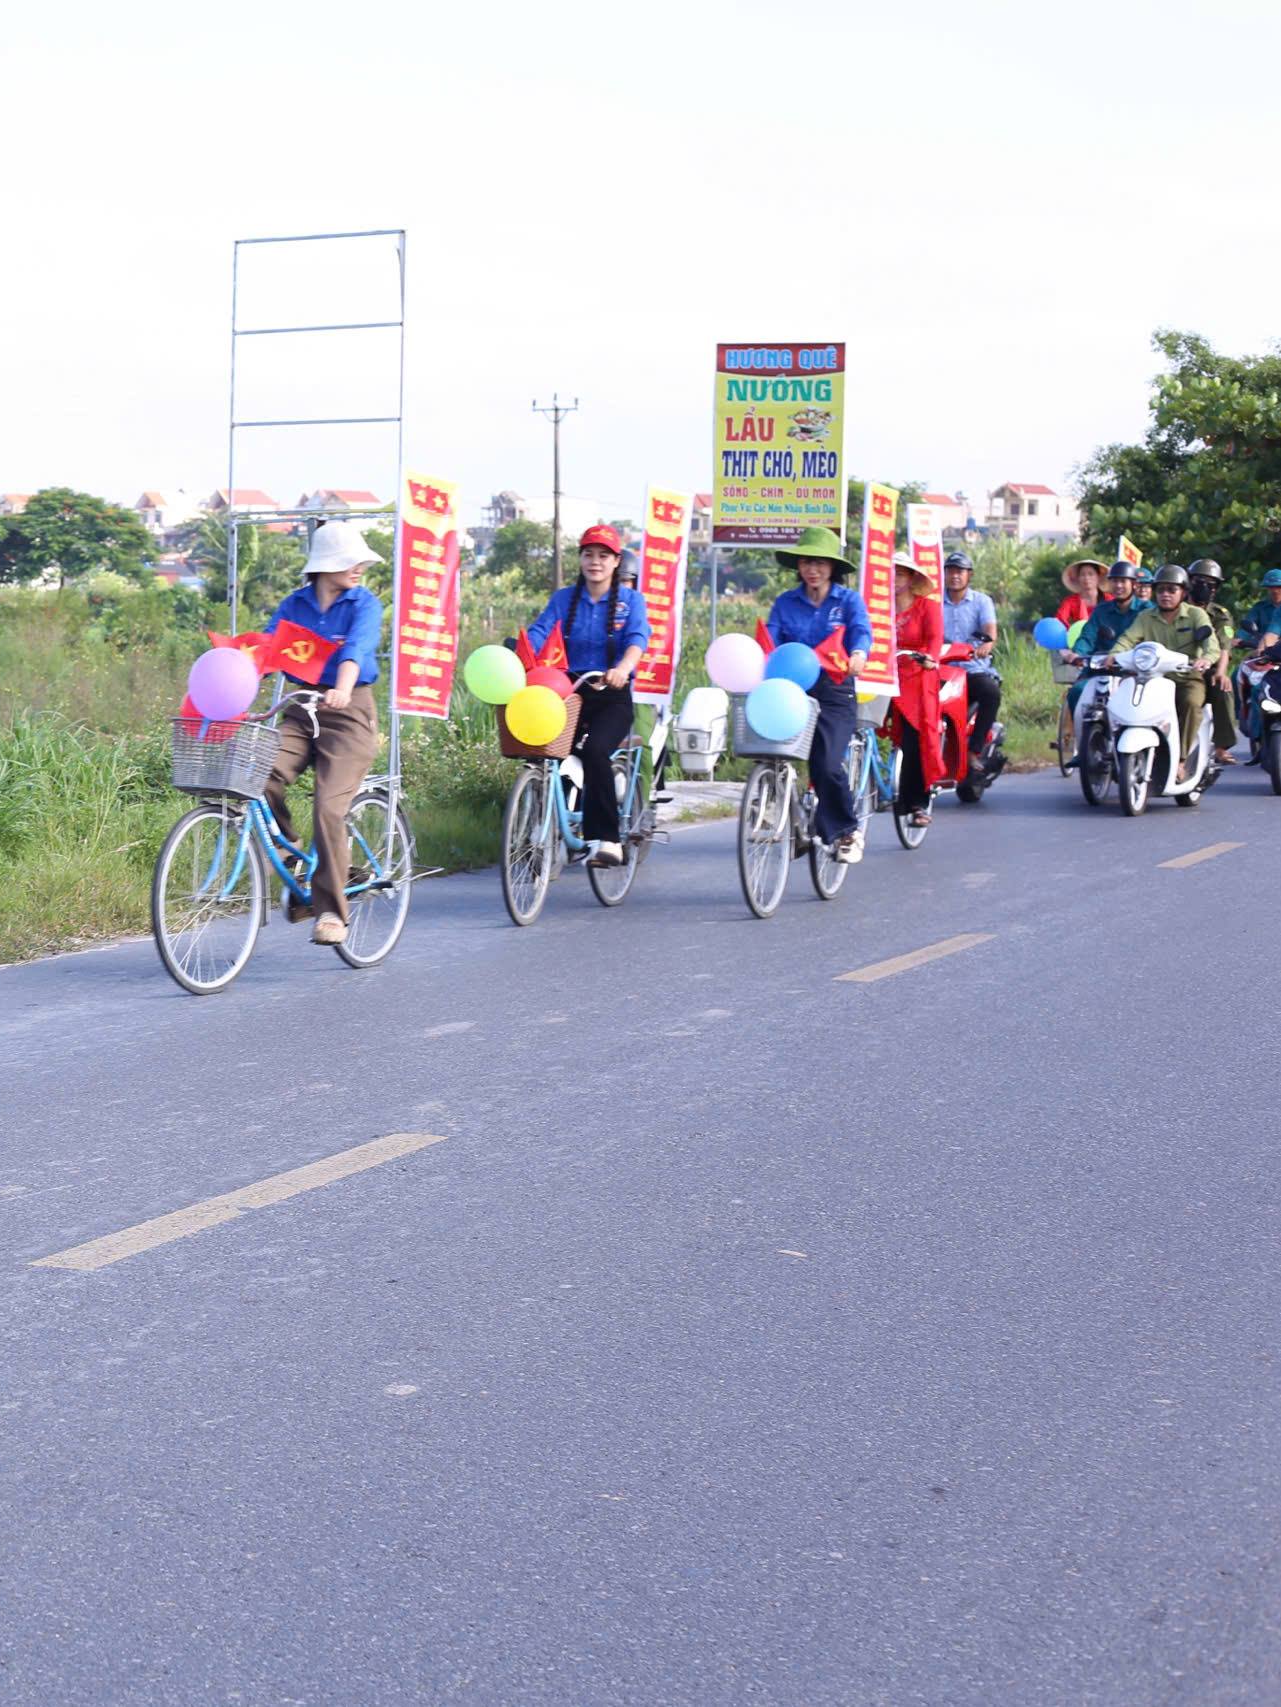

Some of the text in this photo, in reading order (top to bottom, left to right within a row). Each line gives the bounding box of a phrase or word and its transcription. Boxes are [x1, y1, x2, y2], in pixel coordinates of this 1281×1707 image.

[725, 345, 837, 369] HƯƠNG QUÊ
[726, 373, 833, 402] NƯỚNG
[725, 406, 775, 442] LẨU
[722, 446, 837, 482] THỊT CHÓ, MÈO
